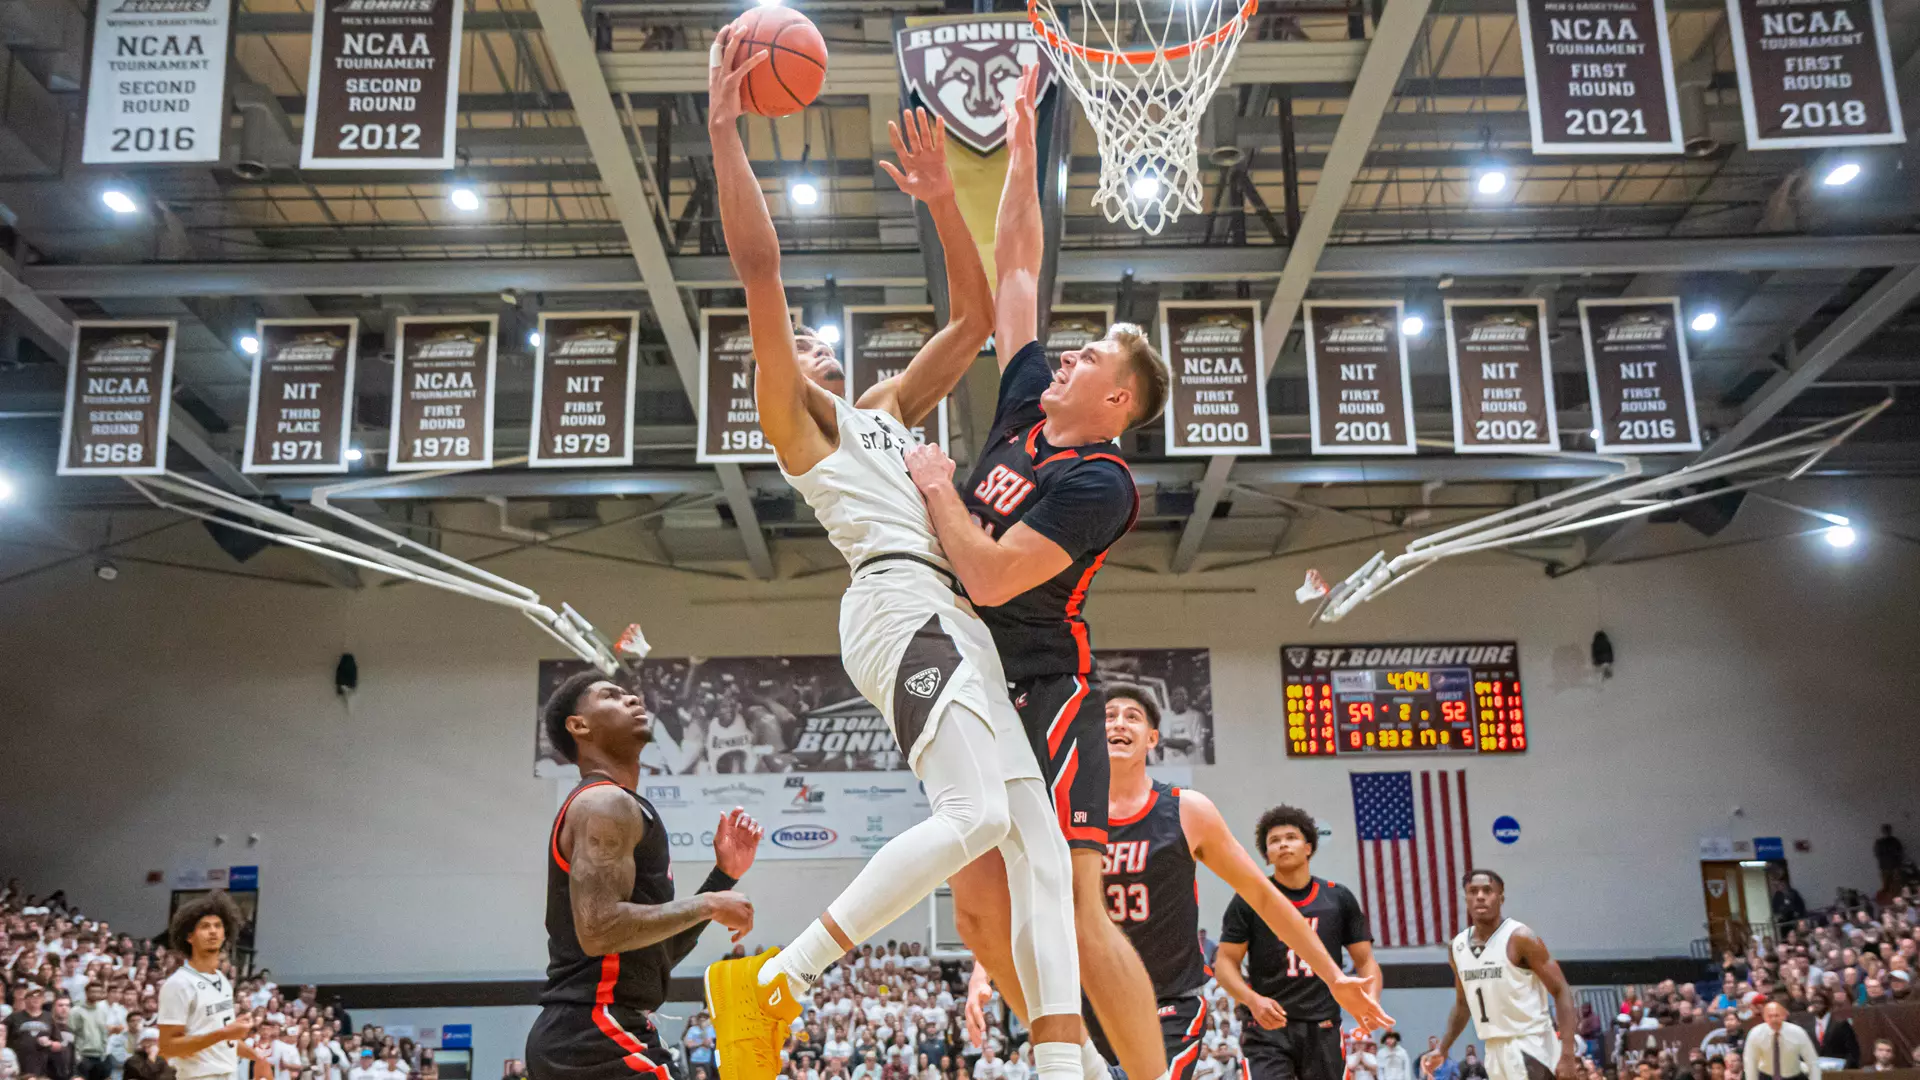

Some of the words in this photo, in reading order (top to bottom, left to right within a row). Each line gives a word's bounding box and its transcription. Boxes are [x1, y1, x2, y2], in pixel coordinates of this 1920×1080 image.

[374, 17, 434, 25] BASKETBALL
[1550, 18, 1639, 40] NCAA
[1762, 9, 1854, 36] NCAA
[342, 33, 431, 55] NCAA
[904, 22, 1036, 50] BONNIE
[1760, 32, 1863, 50] TOURNAMENT
[117, 35, 204, 56] NCAA
[1547, 43, 1645, 55] TOURNAMENT
[108, 59, 210, 72] TOURNAMENT
[335, 57, 435, 69] TOURNAMENT
[1571, 63, 1626, 79] FIRST
[1784, 55, 1843, 73] FIRST
[119, 81, 196, 95] SECOND
[346, 78, 421, 94] SECOND
[1568, 81, 1635, 97] ROUND
[1783, 73, 1852, 91] ROUND
[122, 99, 190, 114] ROUND
[348, 97, 415, 112] ROUND
[1565, 108, 1647, 135] 2021
[1780, 100, 1867, 129] 2018
[111, 126, 195, 152] 2016
[338, 124, 421, 151] 2012
[1183, 358, 1244, 375] NCAA
[1340, 364, 1377, 381] NIT
[1482, 363, 1519, 379] NIT
[1620, 362, 1656, 379] NIT
[88, 378, 149, 394] NCAA
[414, 372, 474, 389] NCAA
[566, 376, 604, 393] NIT
[1181, 375, 1247, 385] TOURNAMENT
[283, 383, 321, 399] NIT
[411, 389, 477, 400] TOURNAMENT
[1195, 390, 1234, 402] FIRST
[1341, 389, 1379, 401] FIRST
[1483, 387, 1522, 399] FIRST
[1623, 387, 1661, 399] FIRST
[424, 405, 462, 417] FIRST
[564, 401, 603, 414] FIRST
[731, 398, 753, 410] FIR
[1193, 403, 1239, 415] ROUND
[1339, 402, 1385, 415] ROUND
[1481, 401, 1527, 412] ROUND
[1621, 400, 1667, 412] ROUND
[90, 410, 143, 422] SECOND
[281, 408, 320, 420] THIRD
[560, 414, 605, 427] ROUND
[92, 424, 139, 435] ROUND
[278, 421, 320, 433] PLACE
[420, 418, 465, 430] ROUND
[1335, 421, 1392, 441] 2001
[1476, 420, 1537, 440] 2002
[1618, 419, 1676, 440] 2016
[1187, 422, 1249, 443] 2000
[271, 441, 323, 461] 1971
[413, 437, 470, 457] 1978
[553, 434, 611, 454] 1979
[83, 443, 143, 463] 1968
[974, 464, 1035, 516] SFU
[1387, 670, 1429, 692] 4:04
[1349, 702, 1375, 724] 59
[1441, 701, 1467, 722] 52
[1461, 727, 1474, 747] 5
[1073, 811, 1087, 823] SFU
[779, 831, 829, 842] mazza
[1101, 840, 1150, 875] SFU
[1106, 883, 1150, 922] 33
[1476, 987, 1490, 1023] 1
